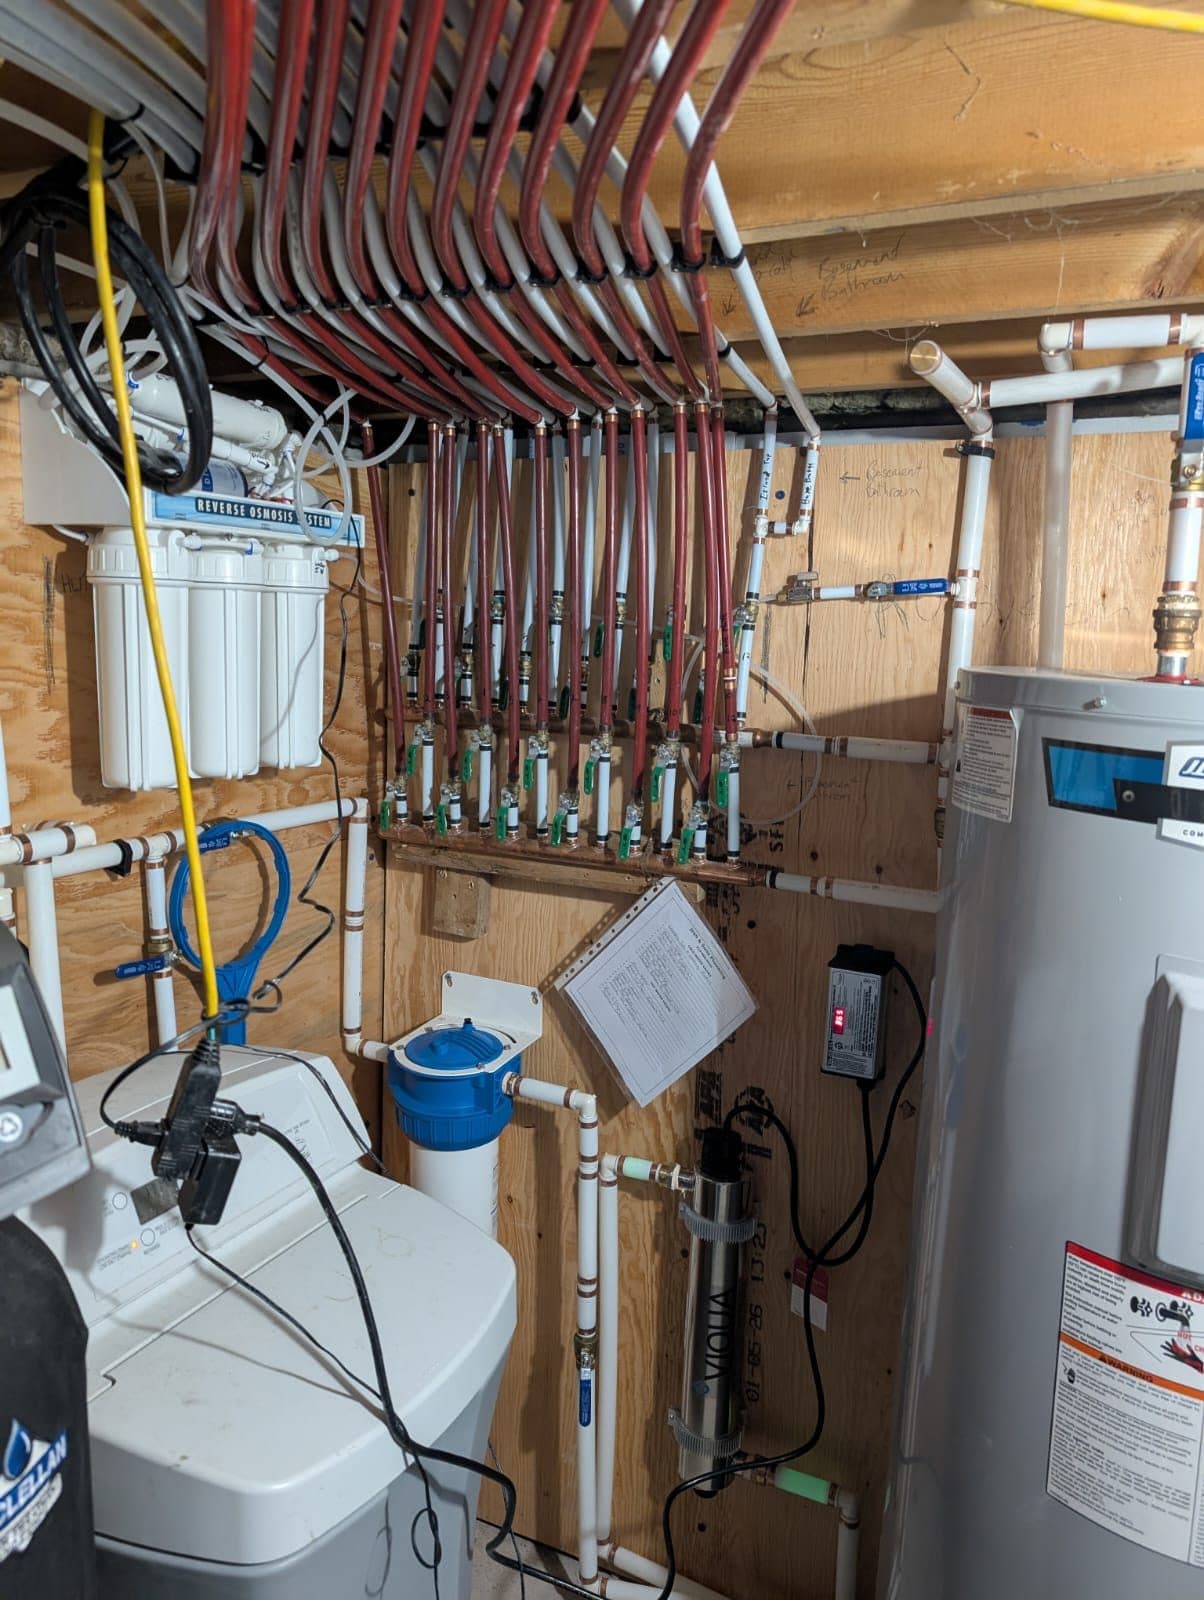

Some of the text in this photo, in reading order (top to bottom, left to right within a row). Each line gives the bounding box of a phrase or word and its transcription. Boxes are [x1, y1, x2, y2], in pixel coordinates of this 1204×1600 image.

[197, 498, 246, 518] REVERSE
[249, 505, 294, 524] OSMOSIS
[1107, 1358, 1154, 1384] WARNING
